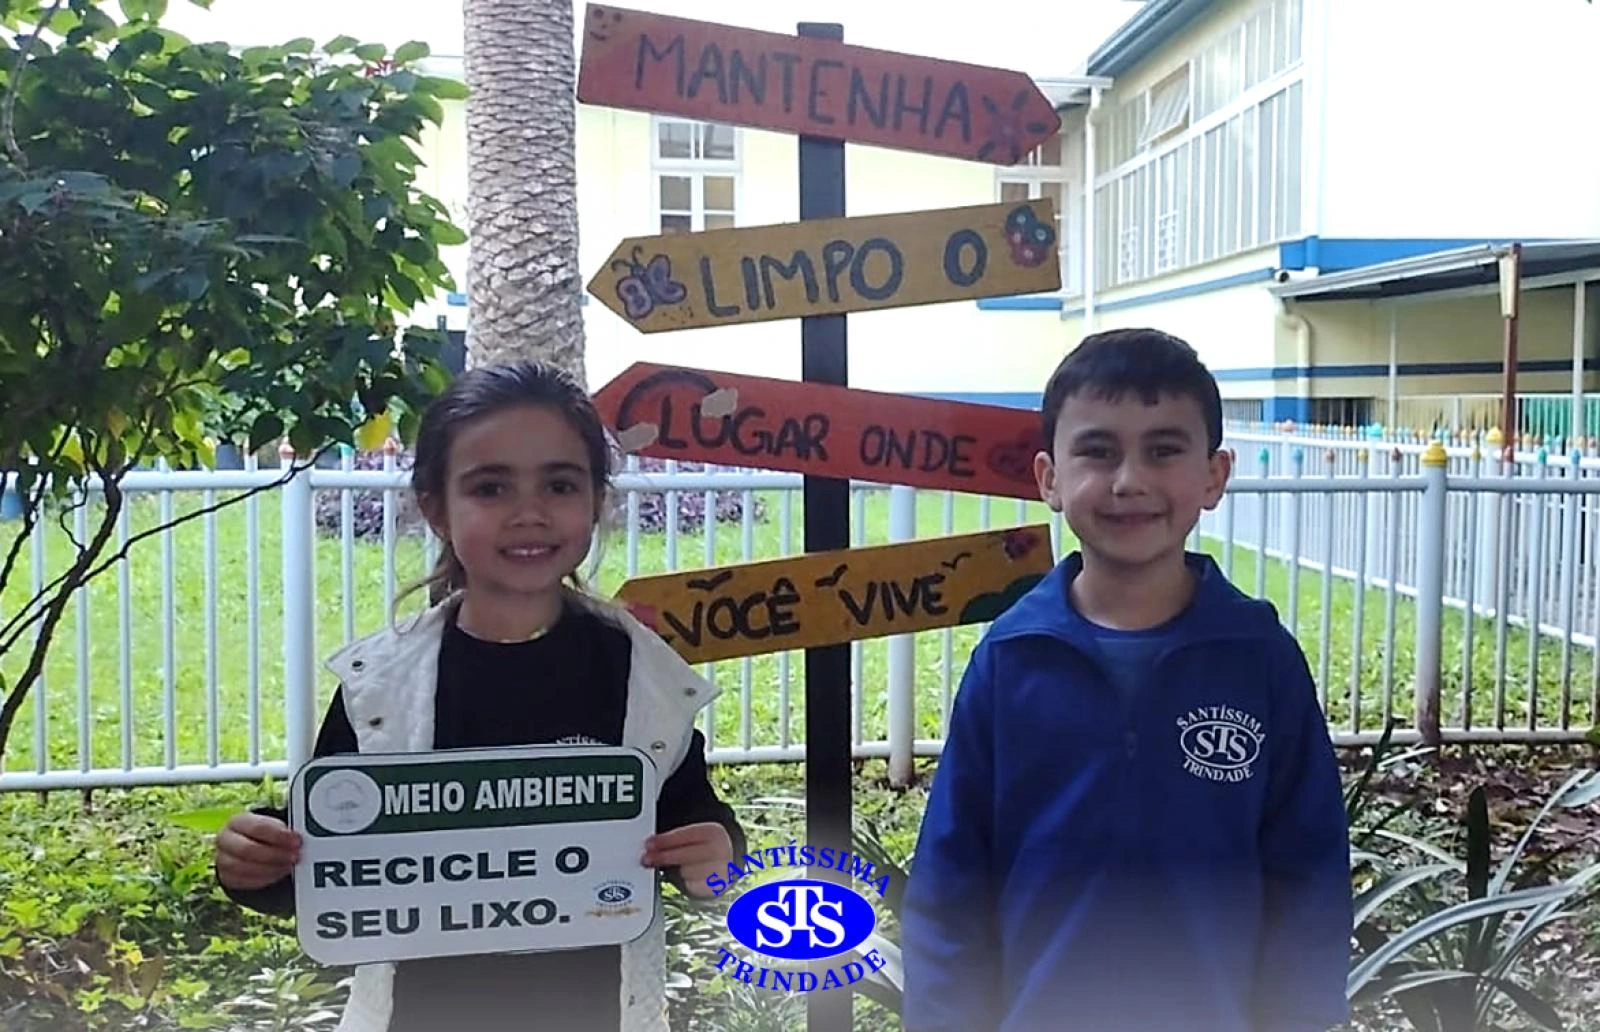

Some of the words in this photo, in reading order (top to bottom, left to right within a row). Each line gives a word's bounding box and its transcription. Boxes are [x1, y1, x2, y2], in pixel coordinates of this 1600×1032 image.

[635, 33, 972, 142] MANTENHA
[701, 238, 904, 318] LIMPO
[943, 228, 988, 287] O
[658, 395, 830, 461] LUGAR
[860, 425, 978, 478] ONDE
[663, 576, 801, 647] VOCÊ
[838, 573, 949, 625] VIVE
[1194, 725, 1248, 762] STS
[1183, 756, 1254, 782] TRINDADE
[384, 781, 465, 816] MEIO
[475, 774, 635, 810] AMBIENTE
[313, 849, 537, 888] RECICLE
[555, 846, 590, 874] O
[316, 906, 420, 940] SEU
[440, 898, 571, 932] LIXO.
